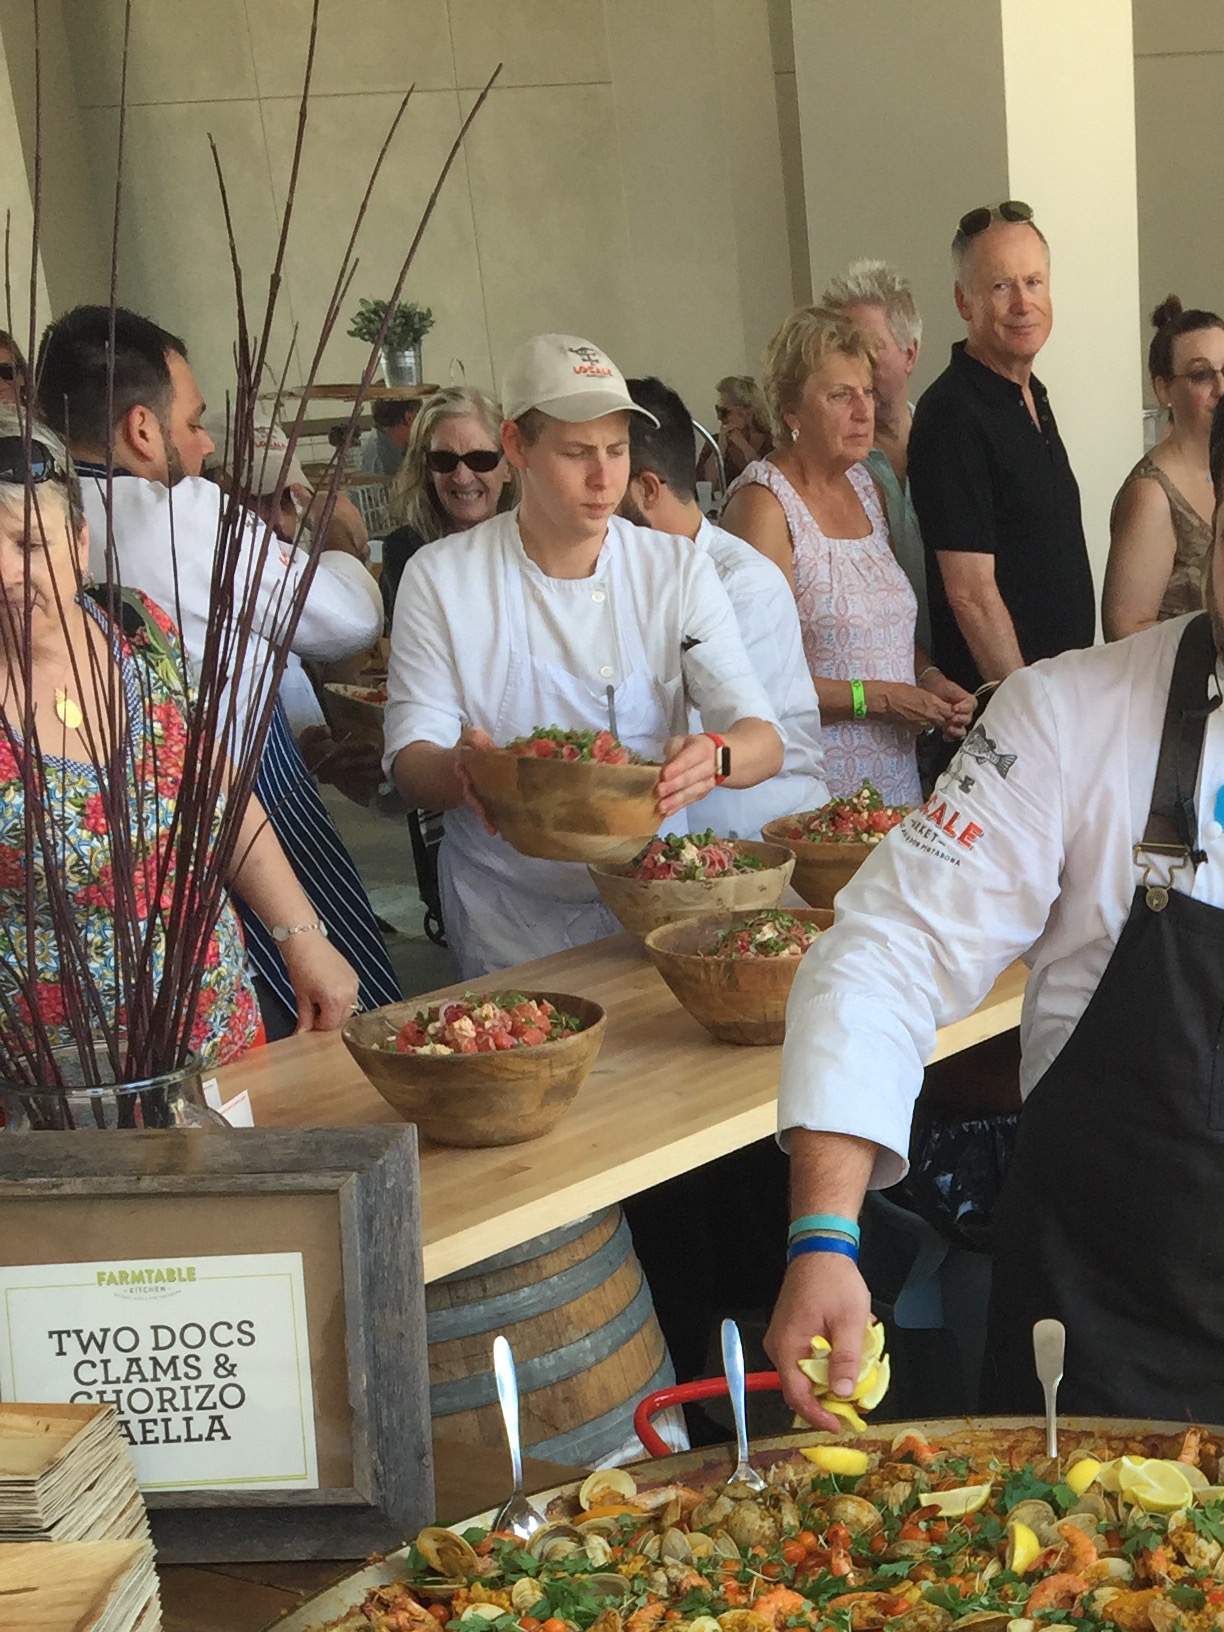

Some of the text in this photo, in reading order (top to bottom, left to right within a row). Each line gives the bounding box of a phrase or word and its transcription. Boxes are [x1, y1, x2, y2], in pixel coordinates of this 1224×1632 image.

[48, 1320, 256, 1357] TWO DOCS
[73, 1353, 238, 1387] CLAMS &
[116, 1414, 232, 1446] AELLA
